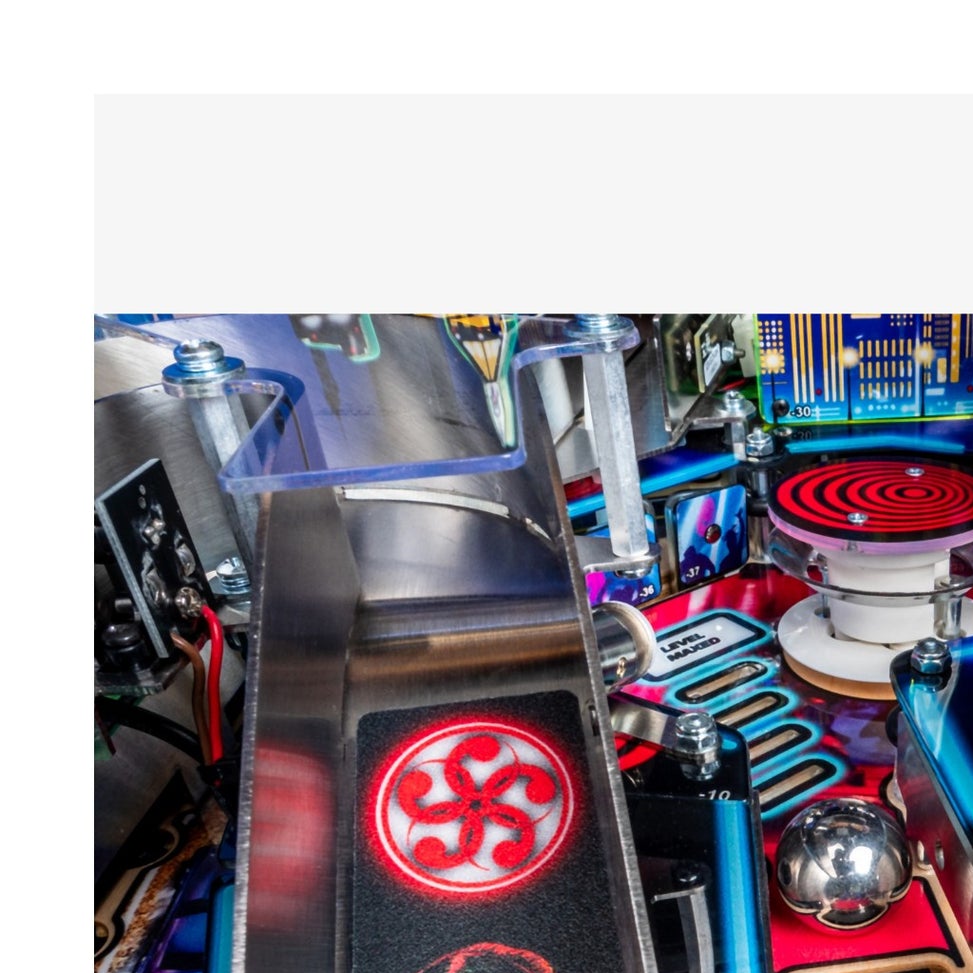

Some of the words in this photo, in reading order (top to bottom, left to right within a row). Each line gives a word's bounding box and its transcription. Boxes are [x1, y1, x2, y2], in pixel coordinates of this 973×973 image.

[791, 406, 811, 417] -30
[686, 566, 700, 578] -37
[640, 585, 655, 597] -36
[660, 633, 706, 653] LEVEL
[667, 637, 721, 662] MAXED
[699, 790, 731, 800] -10
